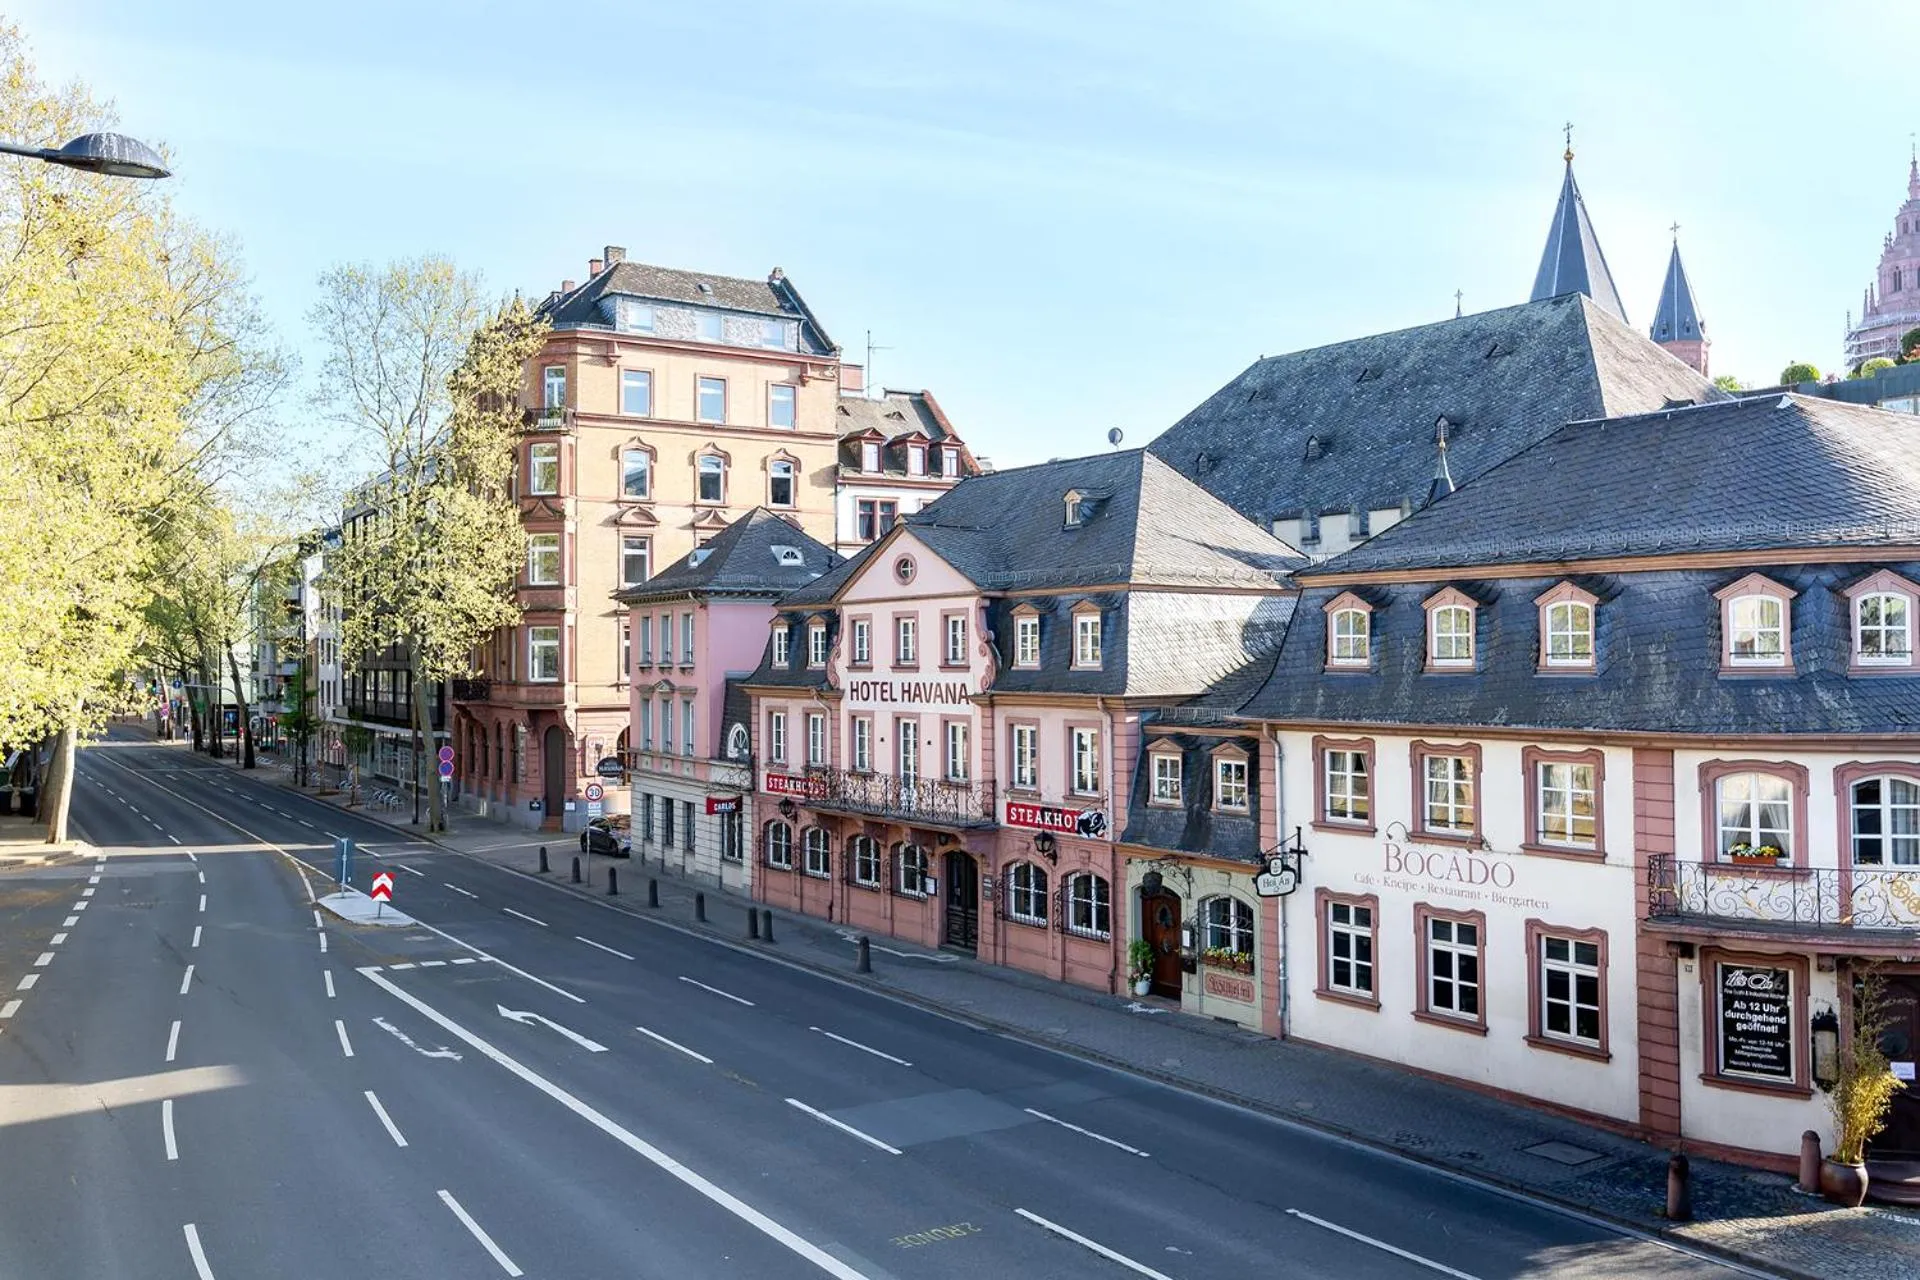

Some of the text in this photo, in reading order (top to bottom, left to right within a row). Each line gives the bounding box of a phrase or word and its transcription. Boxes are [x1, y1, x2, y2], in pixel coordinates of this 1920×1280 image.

[850, 681, 970, 705] HOTEL HAVANA
[589, 788, 600, 797] 30
[1010, 807, 1080, 830] STEAKHO
[1384, 843, 1515, 889] BOCADO
[1383, 876, 1418, 893] Kneipe
[1427, 882, 1481, 901] Restaurant
[1491, 891, 1550, 910] Biergarten
[1724, 1008, 1787, 1025] durchgehend
[1733, 1000, 1780, 1014] Ab 12 Uhr
